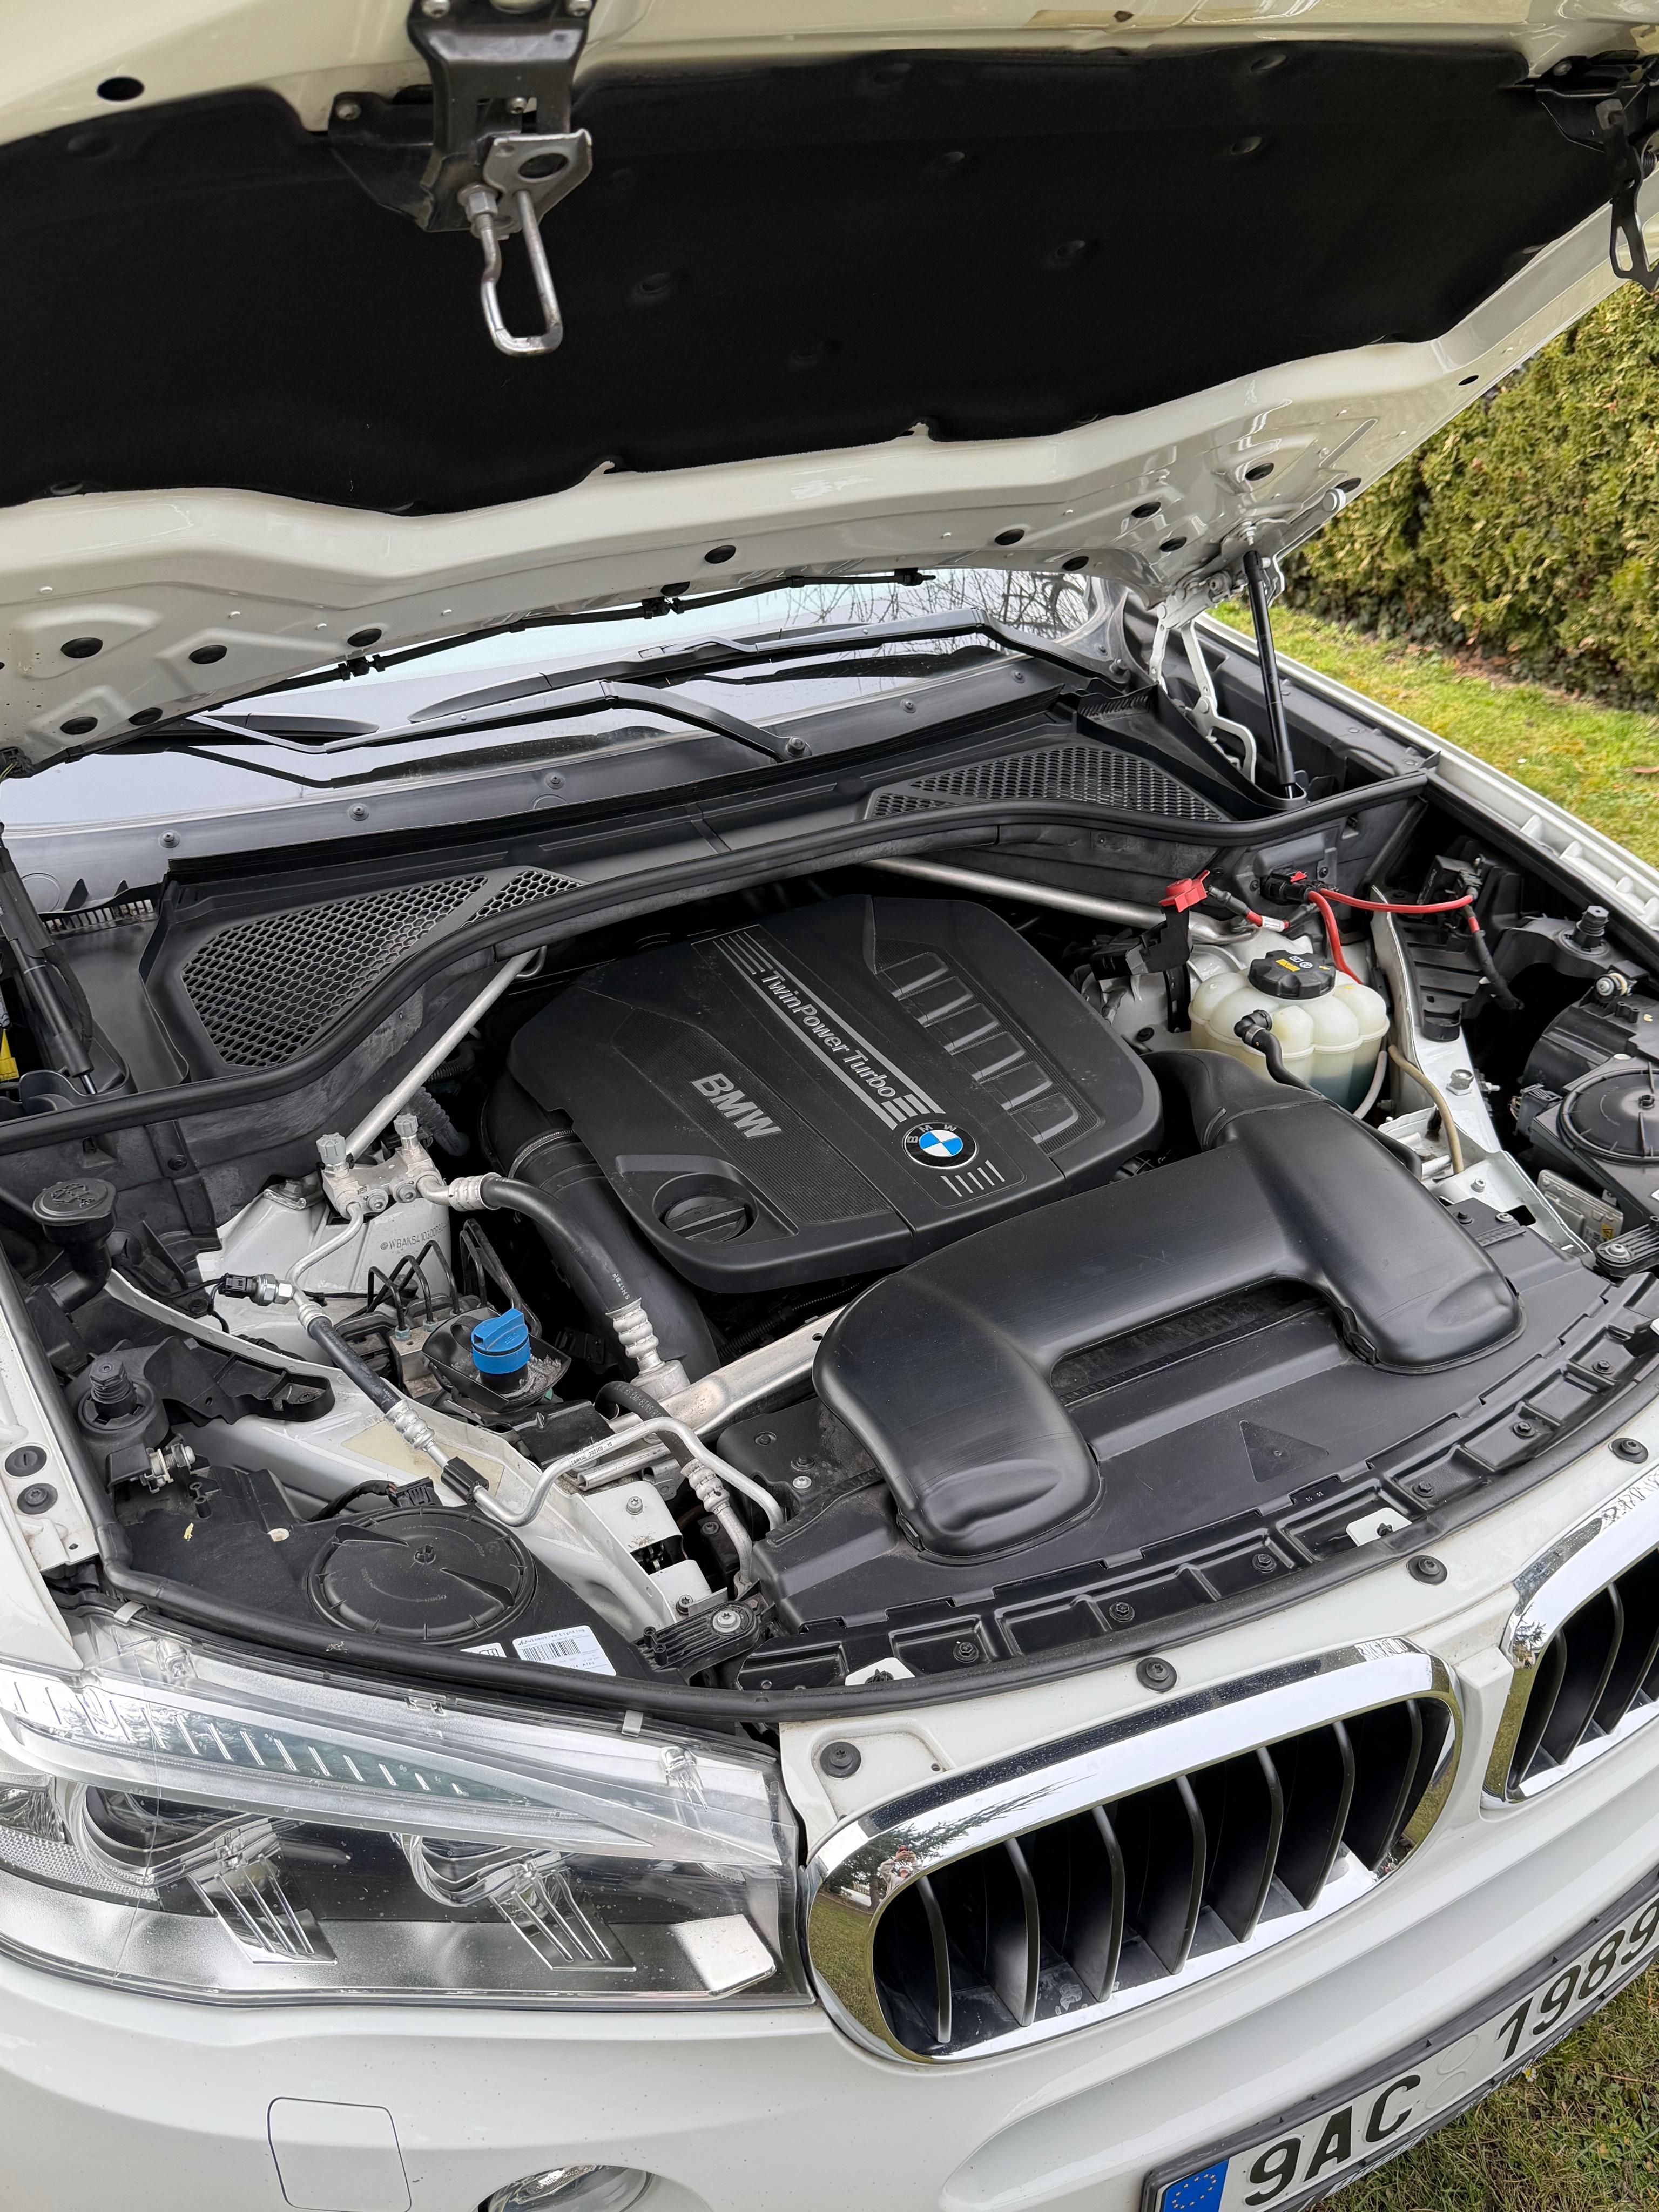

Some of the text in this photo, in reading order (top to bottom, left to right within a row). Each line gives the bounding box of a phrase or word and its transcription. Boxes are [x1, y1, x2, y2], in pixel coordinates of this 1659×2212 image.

[761, 970, 896, 1097] TwinPower Turbo
[692, 1073, 782, 1138] BMW
[907, 1124, 957, 1143] BMW
[1245, 2075, 1421, 2207] 9AC
[1497, 1896, 1659, 2062] 1989
